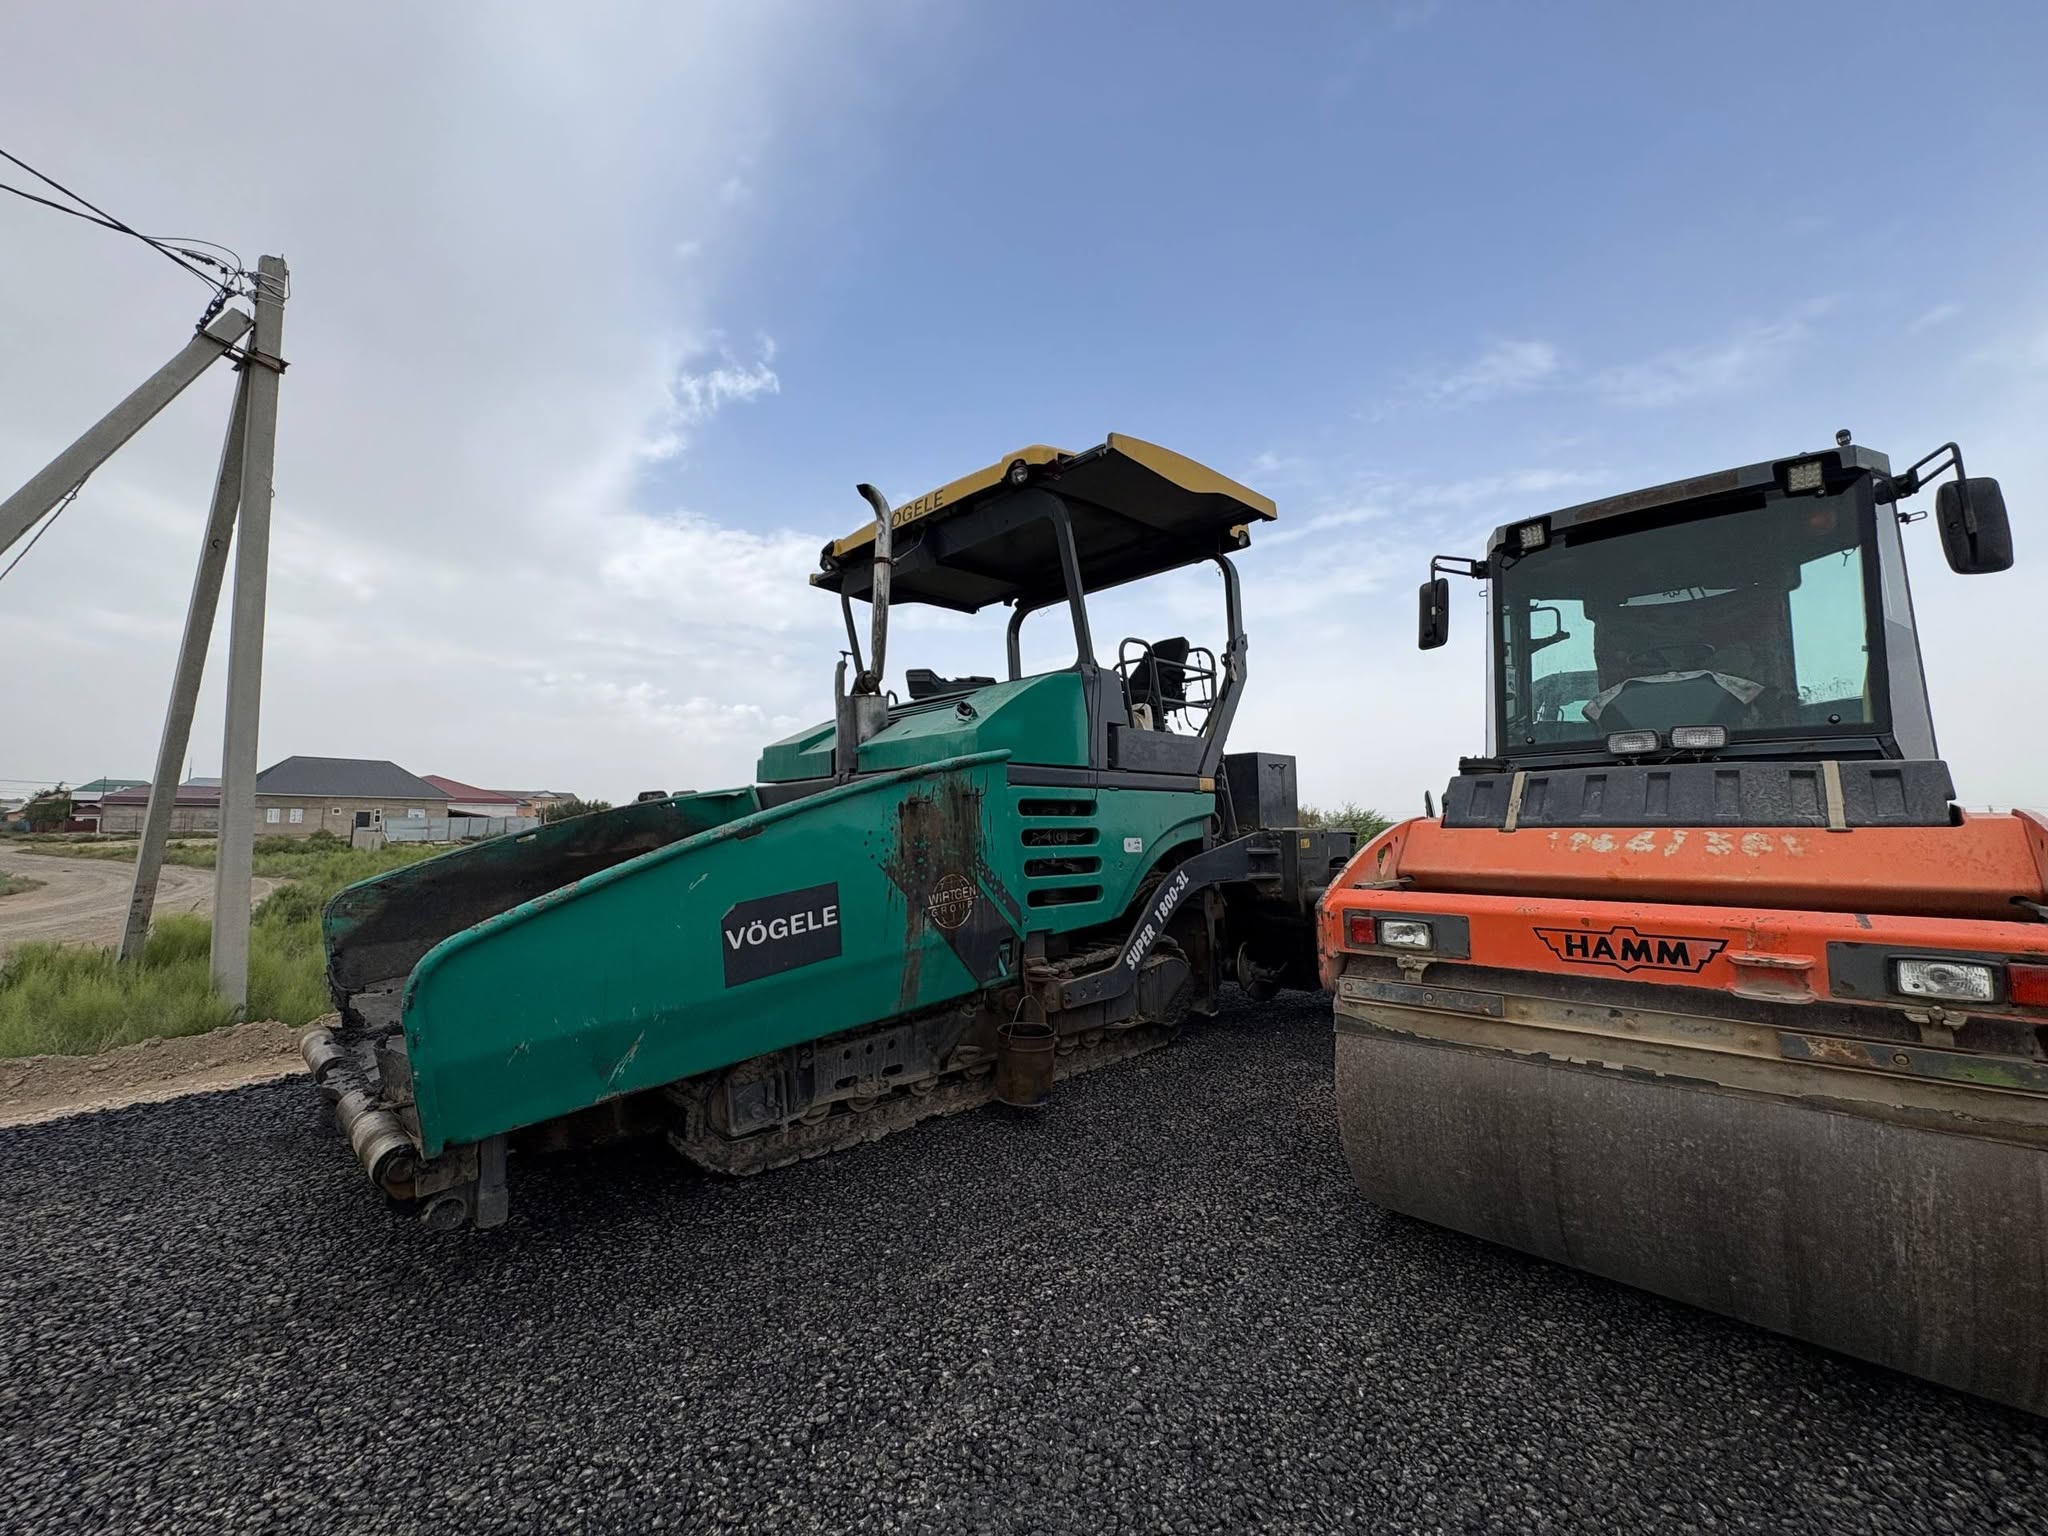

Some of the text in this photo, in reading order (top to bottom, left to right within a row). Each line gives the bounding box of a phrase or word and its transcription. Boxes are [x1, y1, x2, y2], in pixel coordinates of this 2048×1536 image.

[891, 489, 944, 528] ÖGELE
[725, 905, 838, 950] VÖGELE
[1126, 869, 1189, 971] SUPER 1800-3L
[1564, 934, 1691, 967] HAMM
